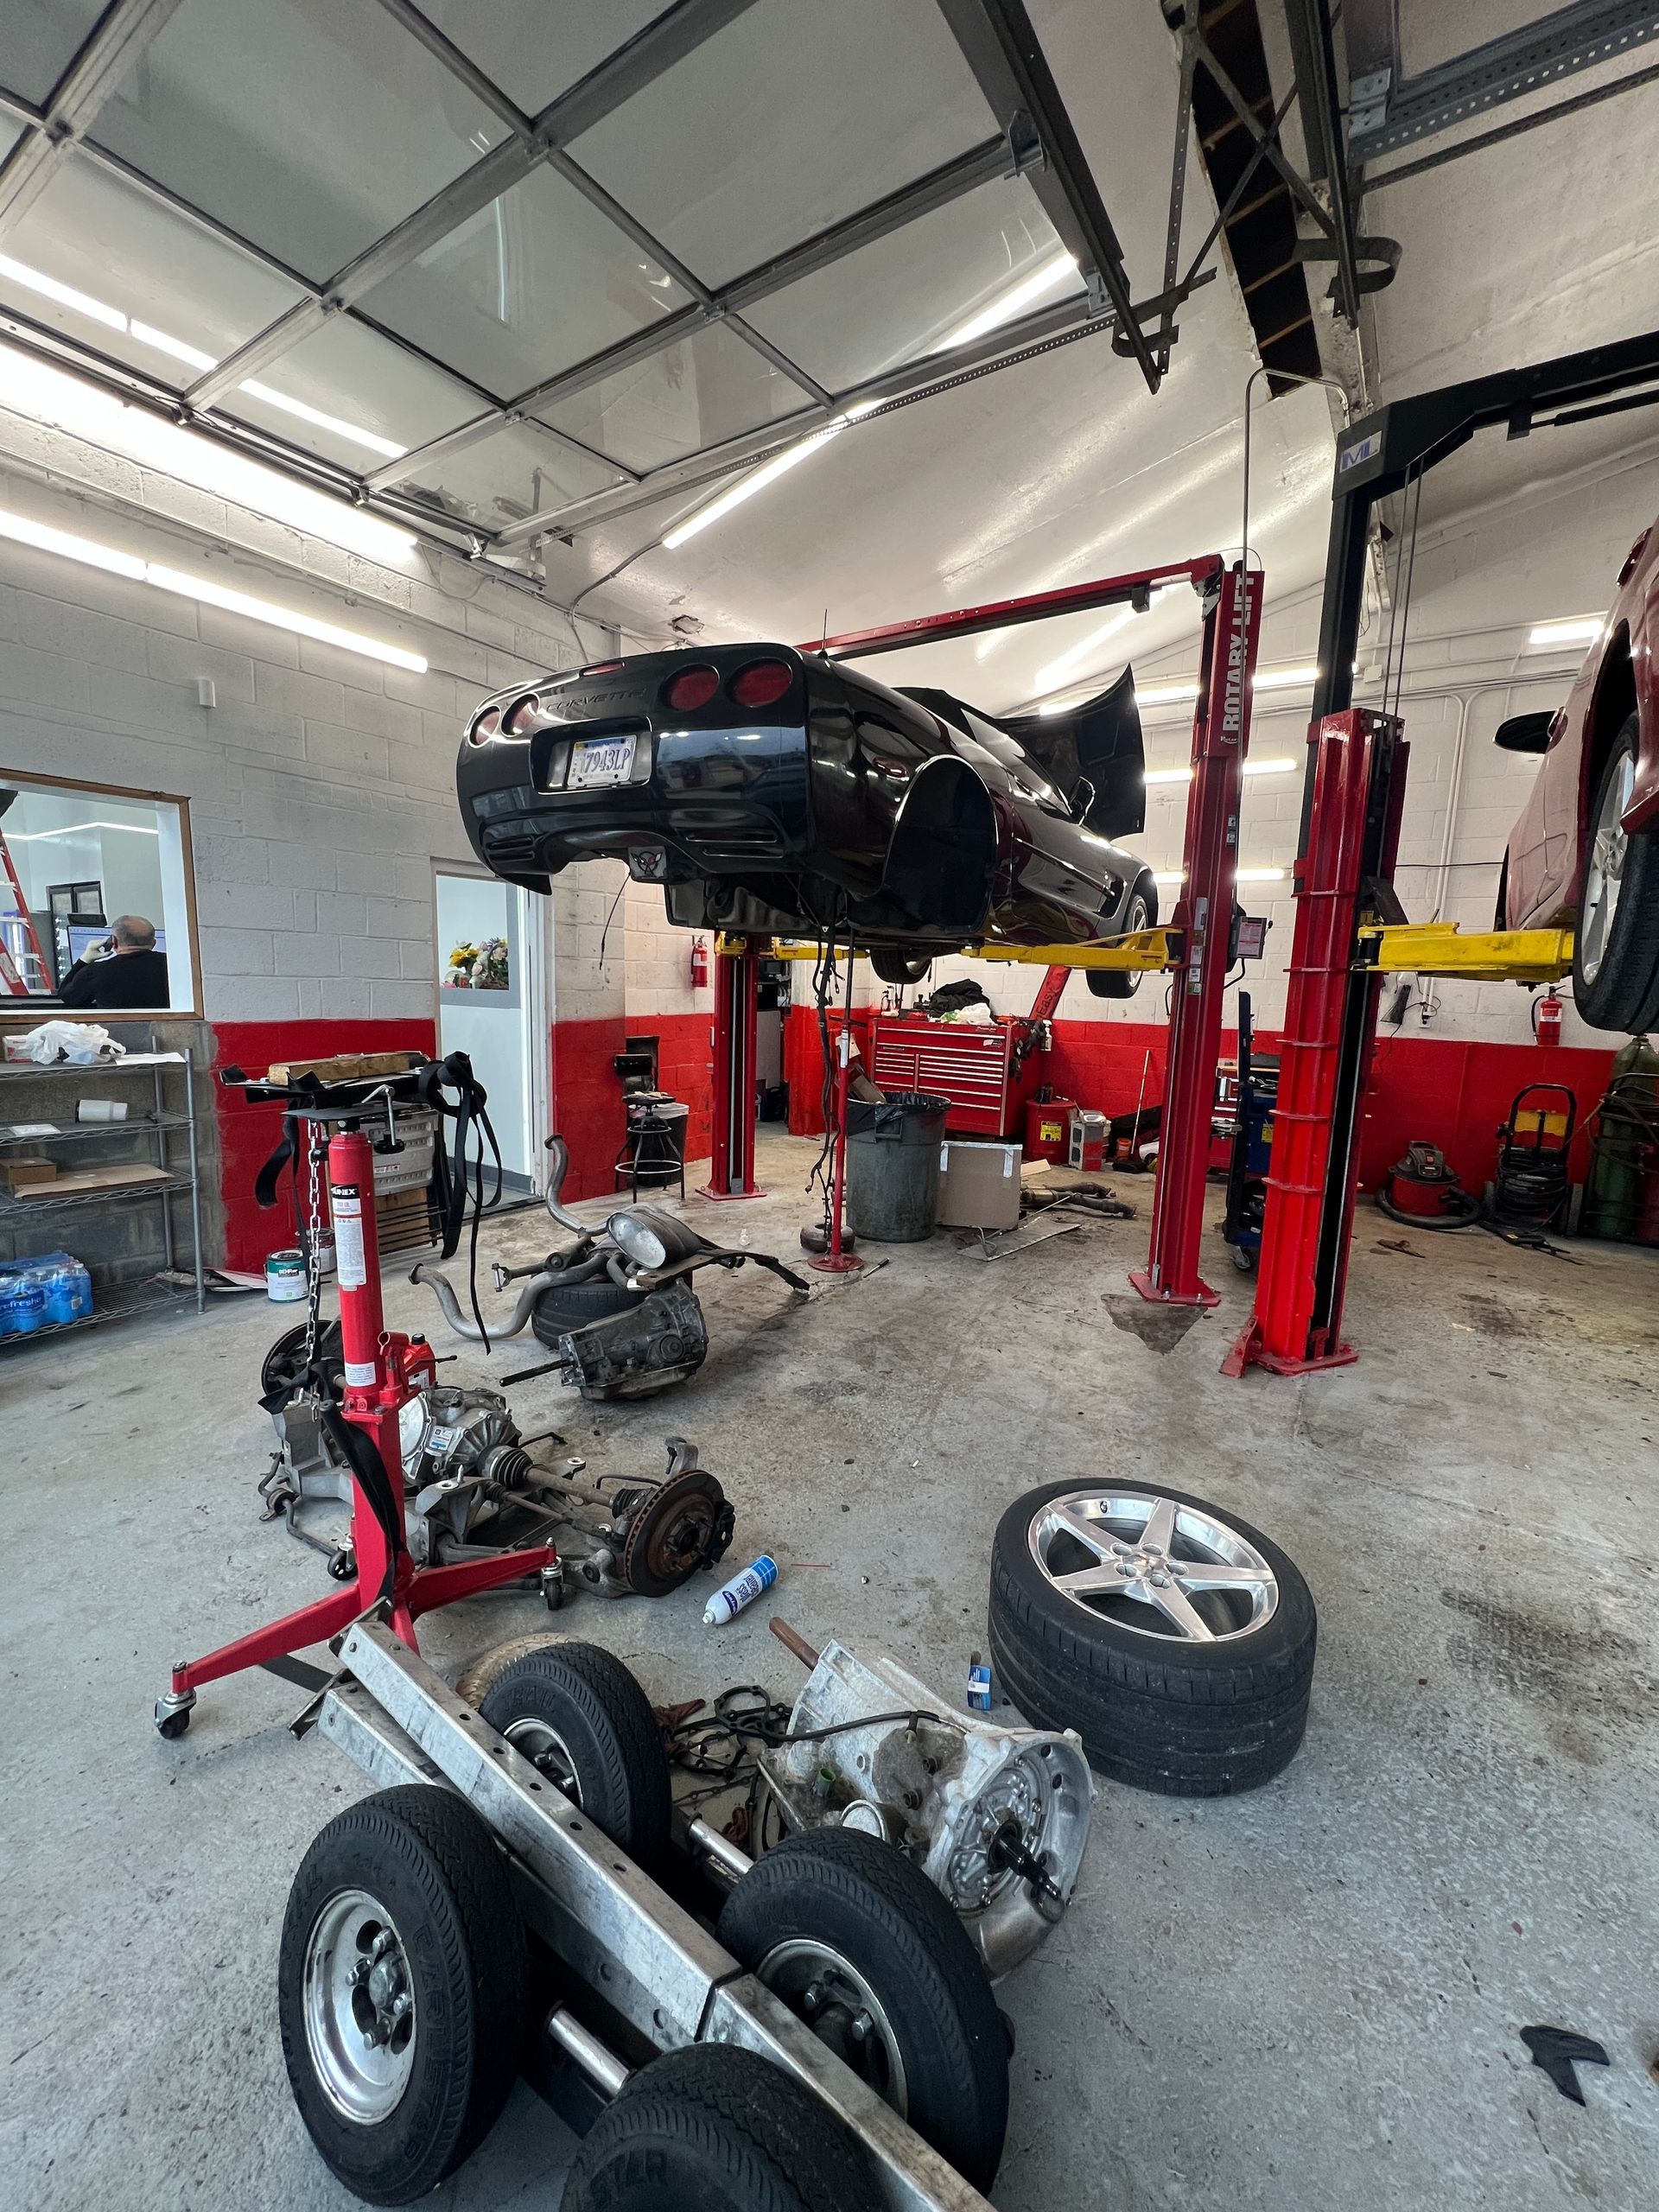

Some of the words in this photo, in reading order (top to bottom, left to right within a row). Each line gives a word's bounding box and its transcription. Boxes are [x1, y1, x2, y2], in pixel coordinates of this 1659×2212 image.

[1232, 574, 1255, 626] LIFT
[546, 690, 646, 711] CORVETTE
[1223, 633, 1249, 731] ROTARY
